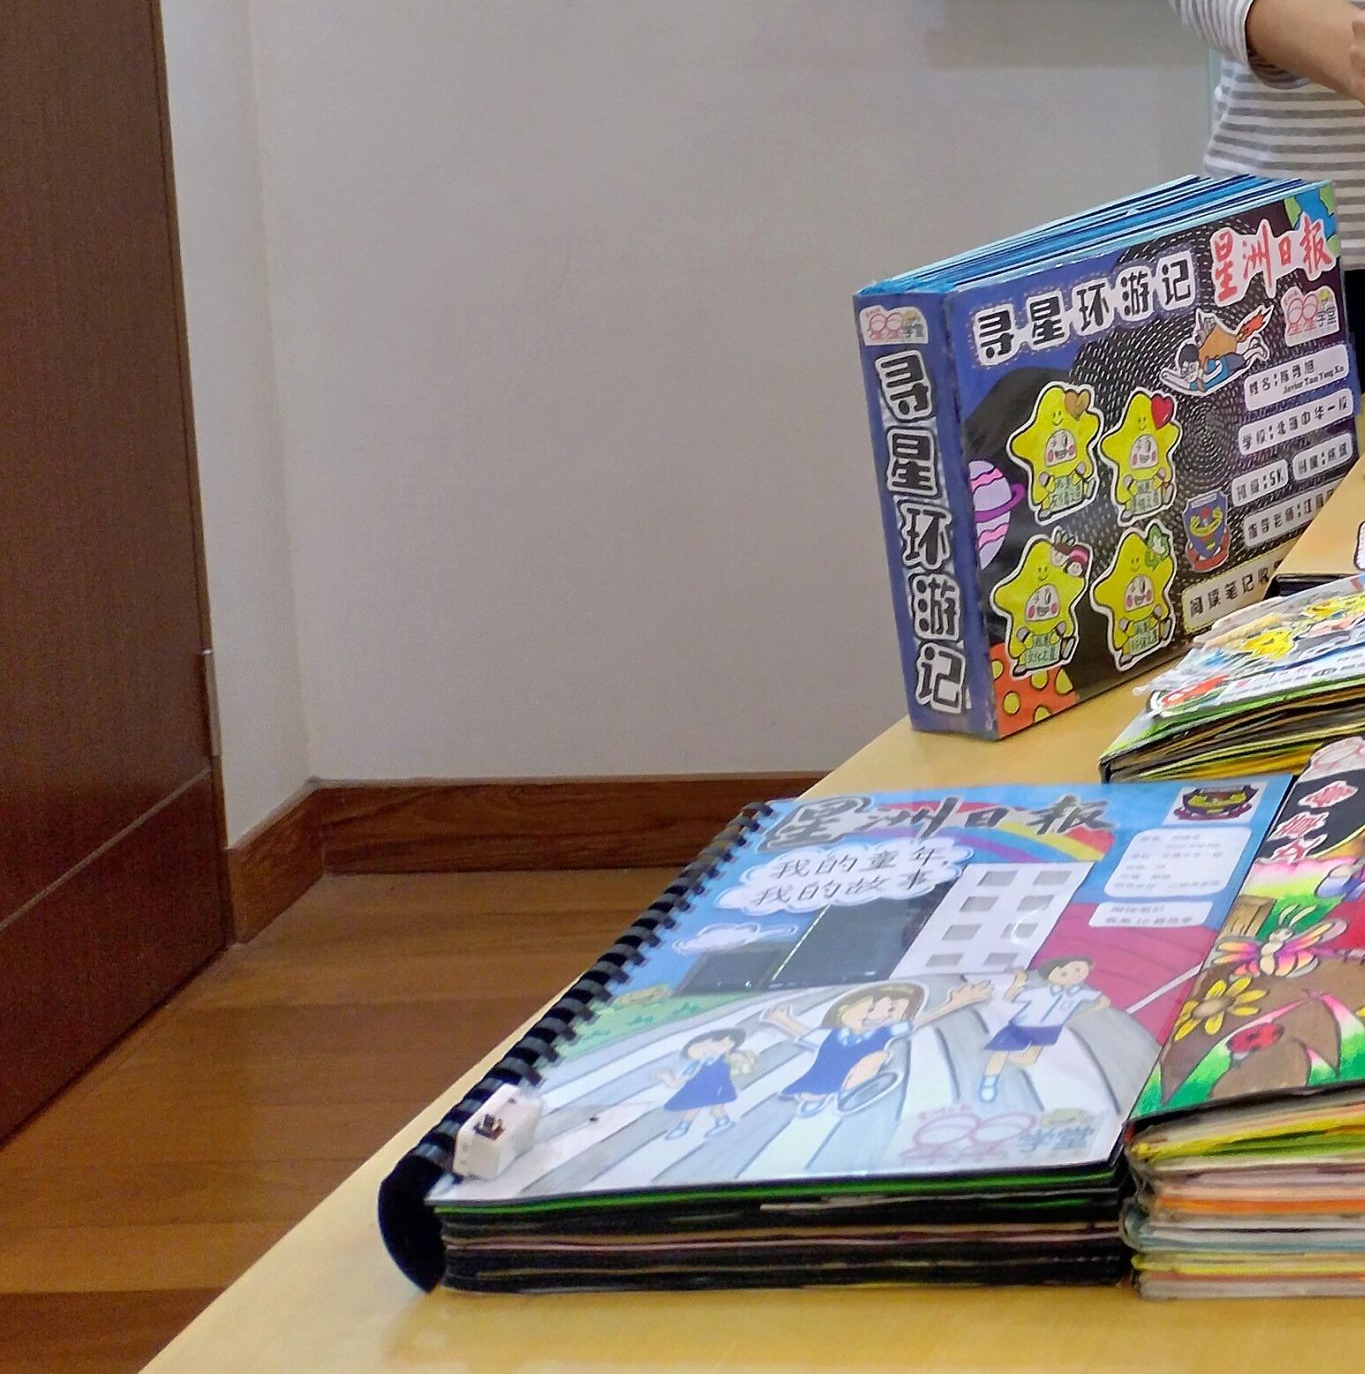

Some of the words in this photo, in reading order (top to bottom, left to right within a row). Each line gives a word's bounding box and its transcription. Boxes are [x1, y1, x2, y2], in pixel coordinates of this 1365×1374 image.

[976, 257, 1194, 360] 寻星环游记
[879, 353, 965, 713] 寻星环游记
